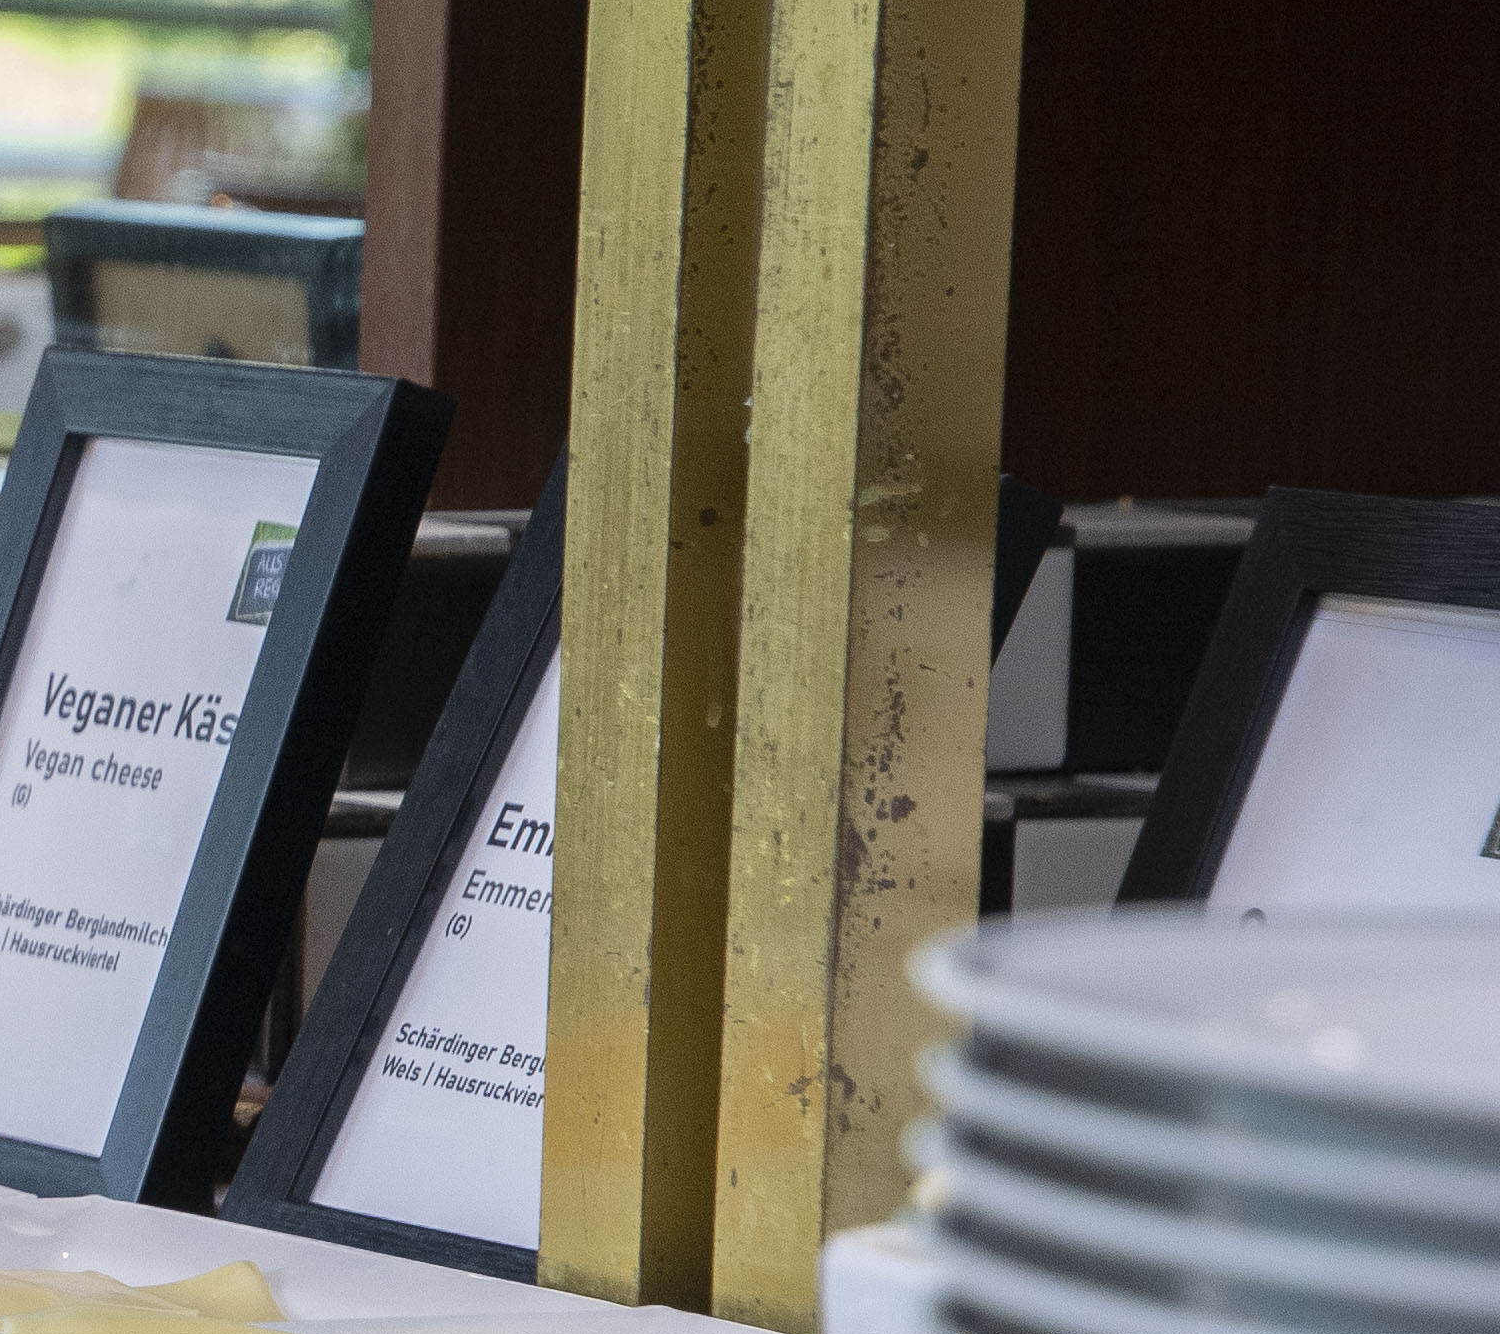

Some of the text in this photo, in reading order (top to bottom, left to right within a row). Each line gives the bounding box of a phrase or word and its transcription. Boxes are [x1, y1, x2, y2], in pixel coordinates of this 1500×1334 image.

[42, 672, 172, 736] Veganer
[24, 738, 164, 791] Vegan cheese
[11, 783, 32, 809] (G)
[486, 801, 553, 857] Em
[64, 907, 169, 949] Berglandmilch
[445, 912, 473, 941] (G)
[10, 931, 121, 973] Hausruckviertel
[395, 1023, 498, 1064] Schärdinger
[382, 1054, 422, 1083] Wels
[433, 1065, 545, 1109] Hausruckvier
